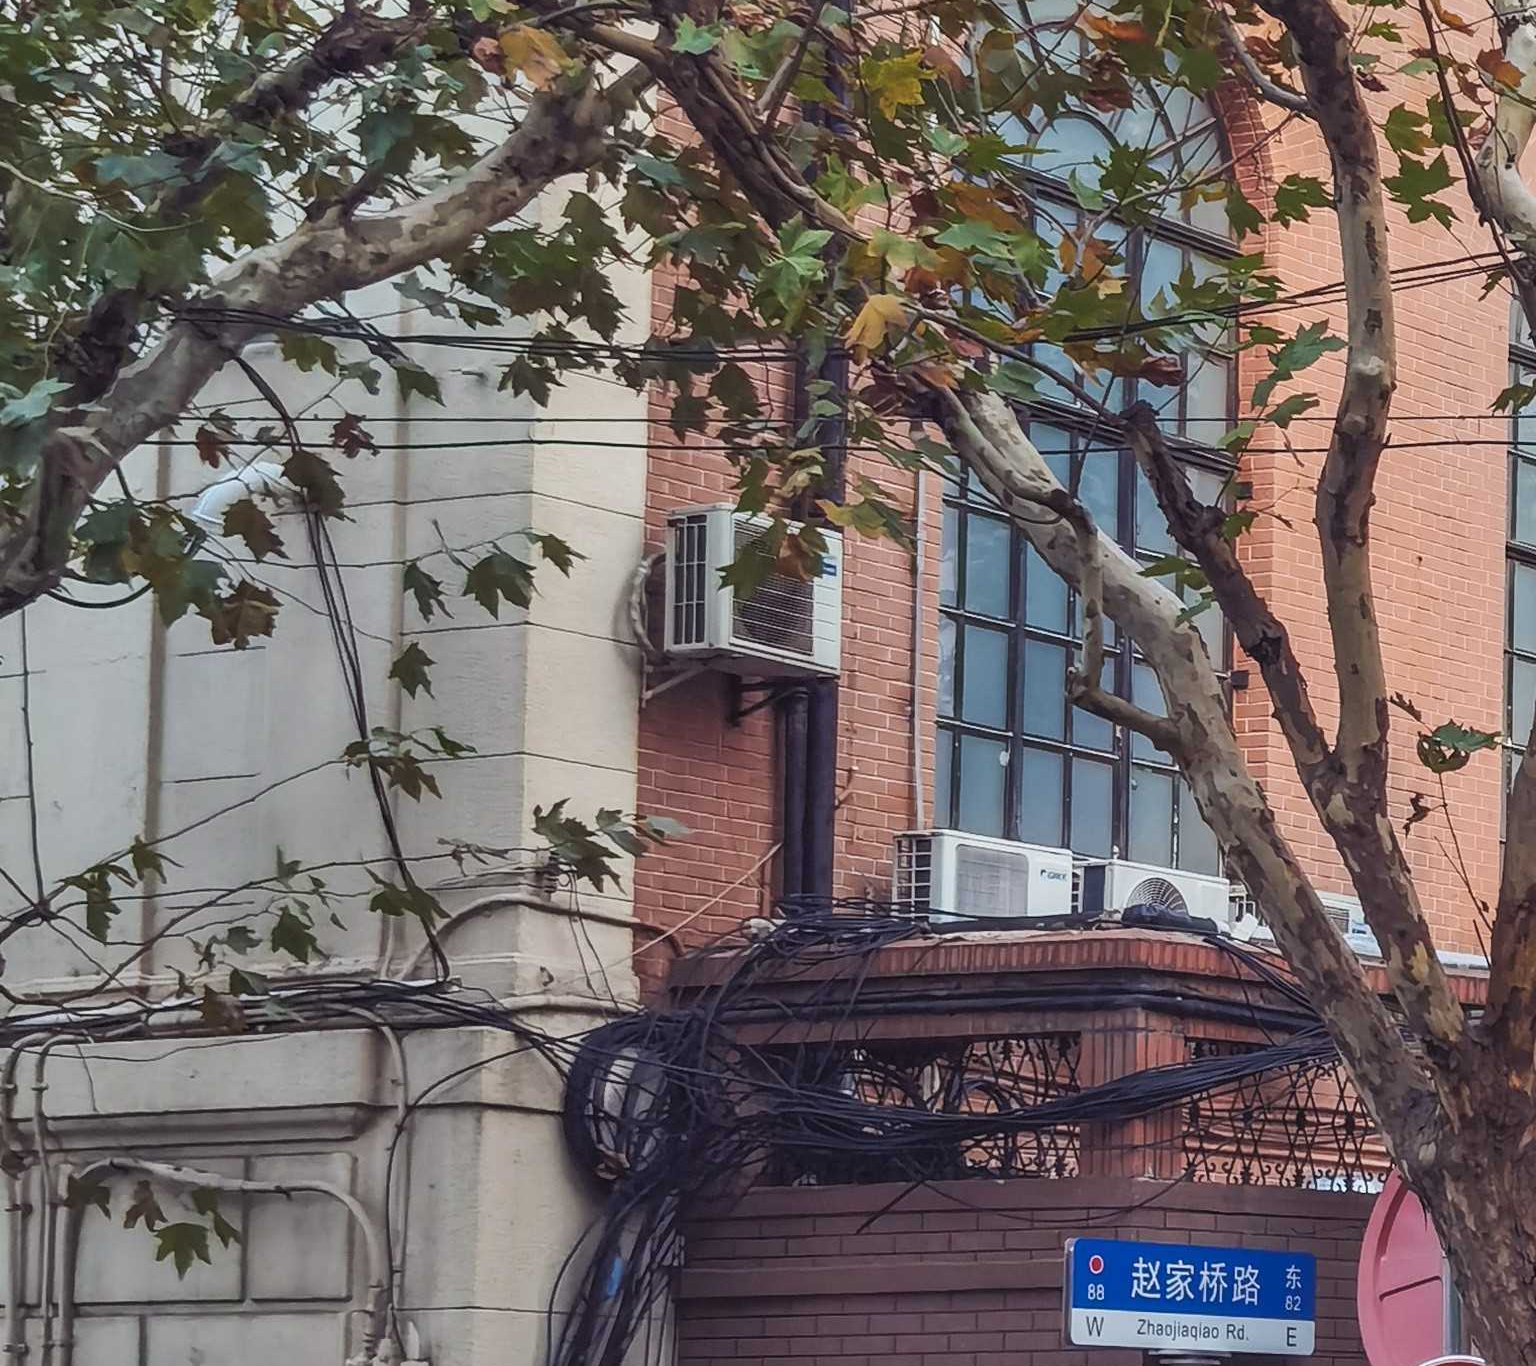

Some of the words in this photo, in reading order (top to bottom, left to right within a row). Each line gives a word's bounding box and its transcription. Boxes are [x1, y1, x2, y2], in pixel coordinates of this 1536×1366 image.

[1130, 1256, 1261, 1307] 赵家桥路
[1284, 1264, 1303, 1290] 东
[1086, 1283, 1105, 1301] 88
[1284, 1295, 1302, 1312] 82
[1086, 1316, 1105, 1337] W
[1136, 1318, 1220, 1342] Zhaojiaqiao
[1225, 1323, 1250, 1342] Rd.
[1286, 1326, 1298, 1348] E
